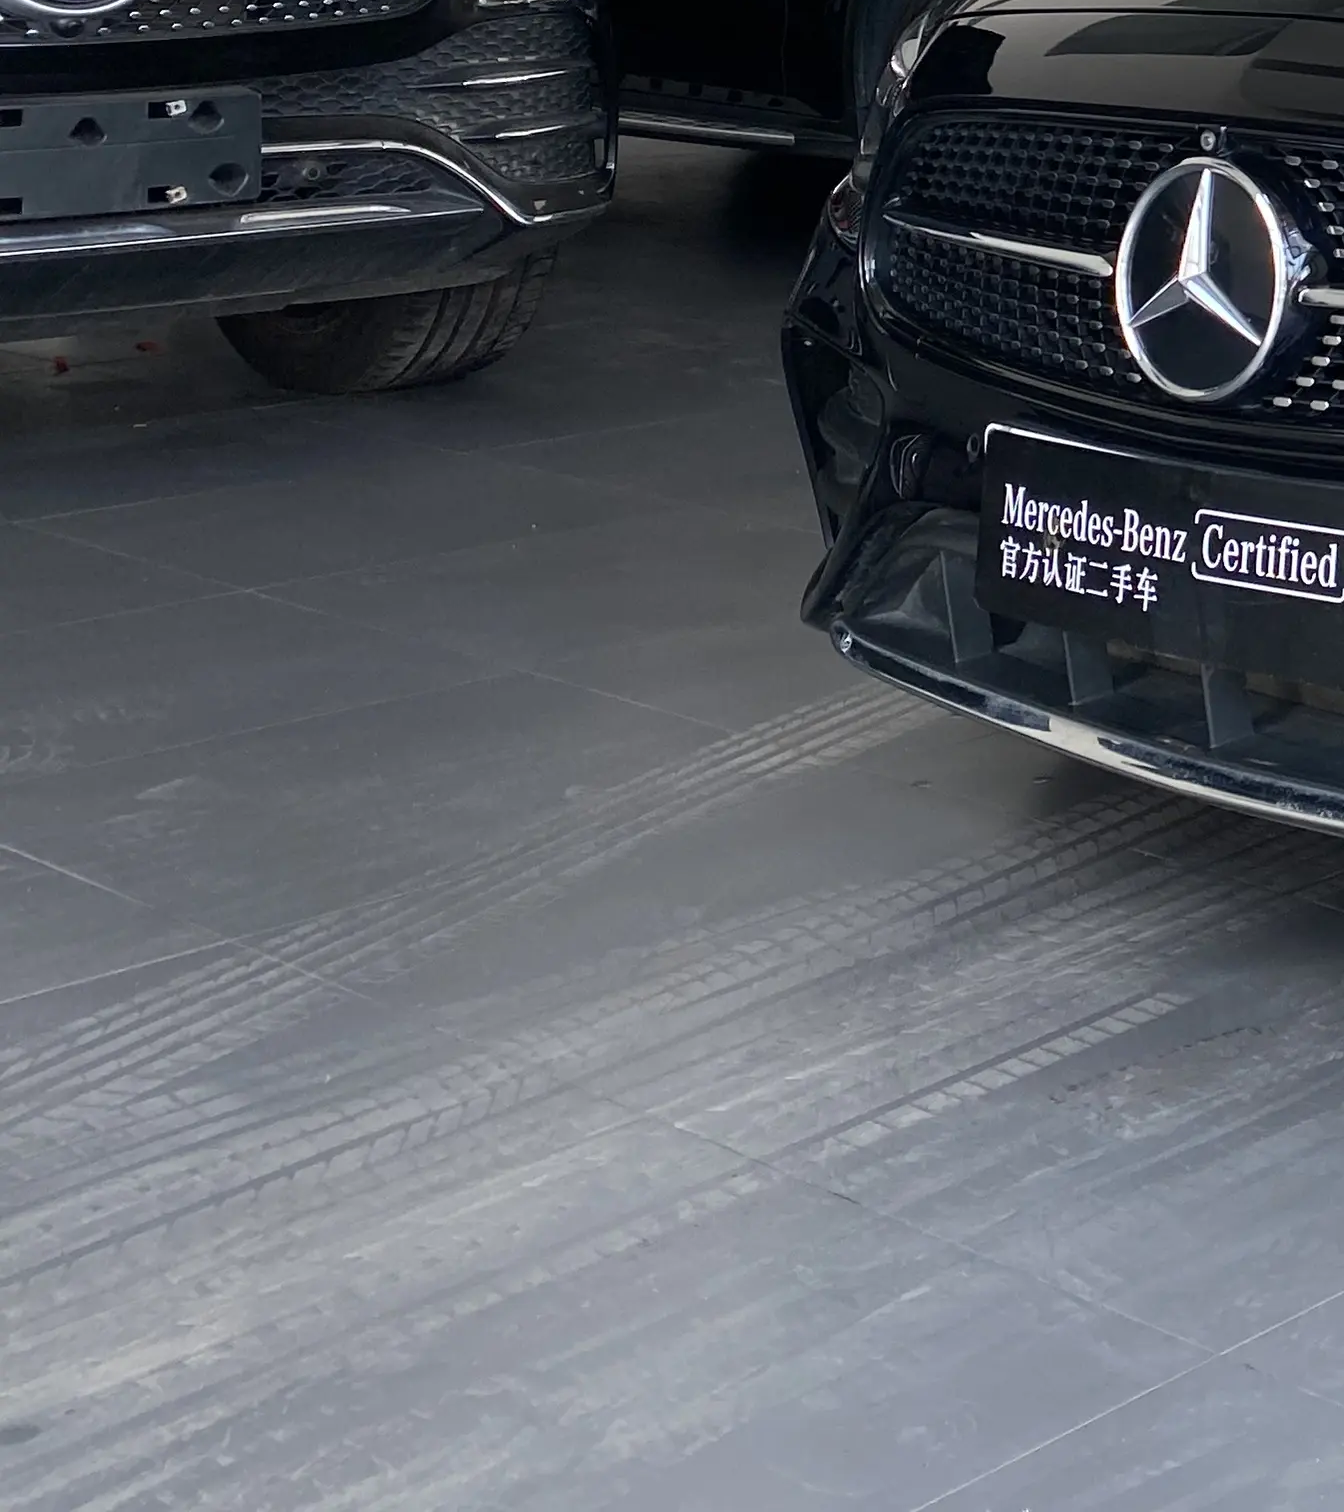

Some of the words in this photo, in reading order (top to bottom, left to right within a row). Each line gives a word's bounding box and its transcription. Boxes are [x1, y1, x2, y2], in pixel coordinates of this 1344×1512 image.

[1000, 535, 1159, 612] 官方认证二手车
[1001, 482, 1188, 563] Mercedes-Benz
[1201, 524, 1339, 589] Certified
